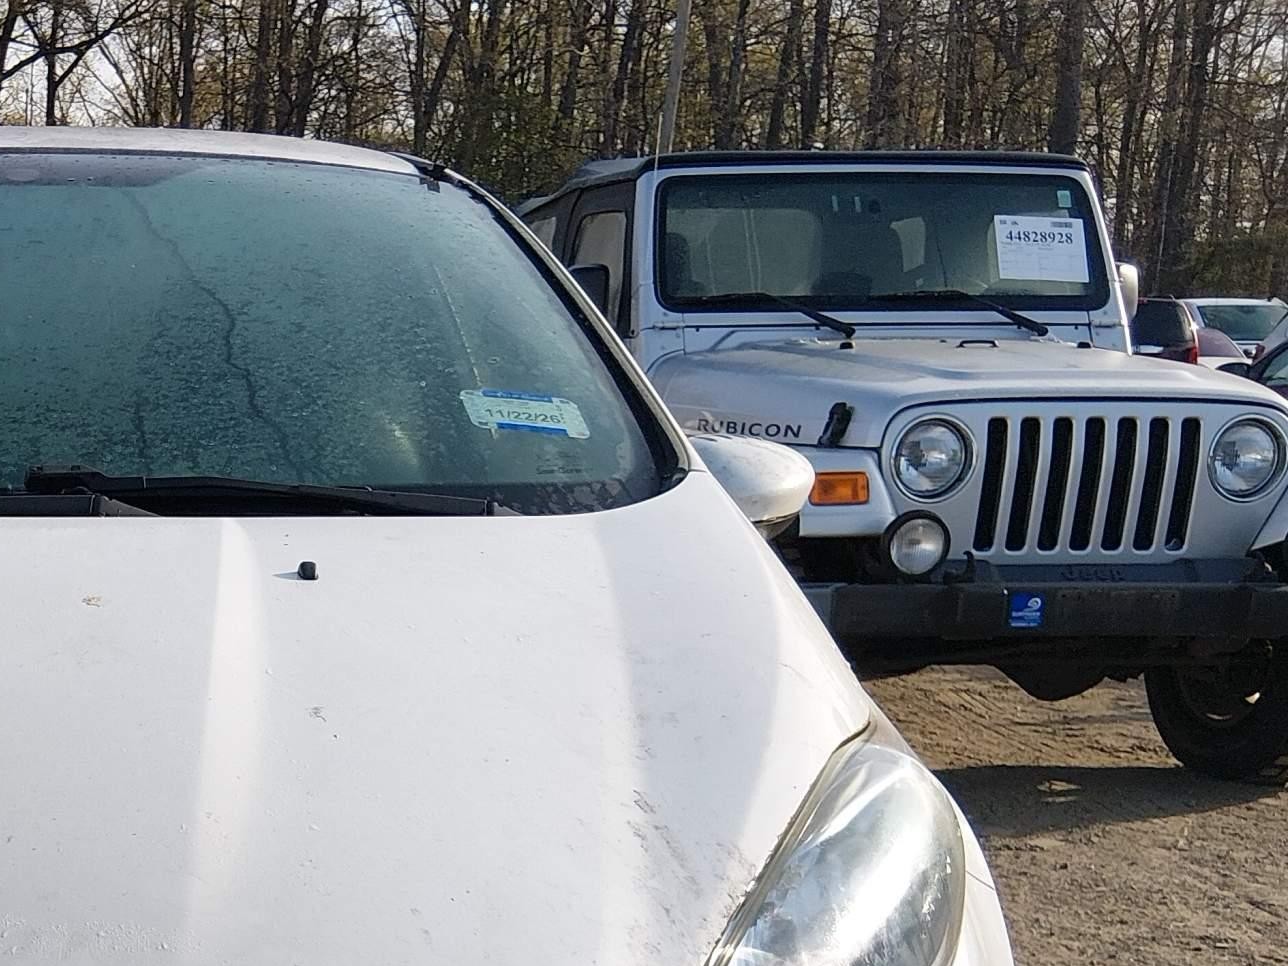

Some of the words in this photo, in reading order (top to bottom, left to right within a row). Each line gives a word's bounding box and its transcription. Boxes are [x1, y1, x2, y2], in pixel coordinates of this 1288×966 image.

[1005, 229, 1073, 245] 44828928
[485, 408, 561, 424] 11/22/26
[696, 418, 802, 438] RUBICON
